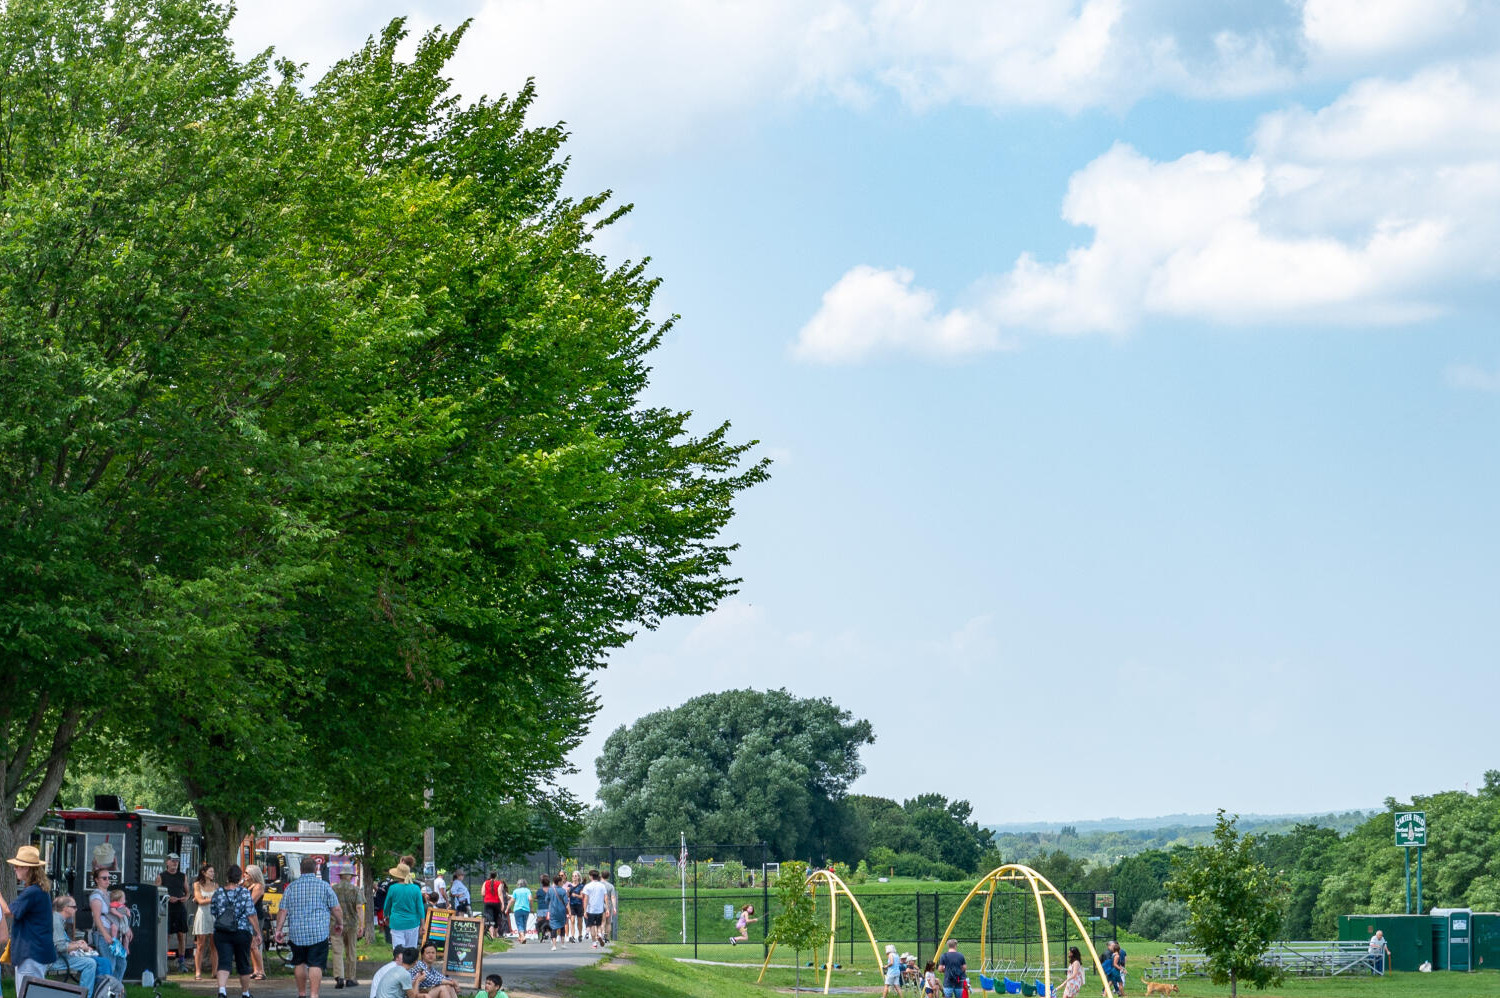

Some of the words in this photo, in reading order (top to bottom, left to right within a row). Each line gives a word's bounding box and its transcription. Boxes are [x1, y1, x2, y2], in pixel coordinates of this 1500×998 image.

[1396, 814, 1412, 828] CARTER
[1413, 814, 1425, 827] FIELD
[143, 838, 164, 856] GELATO
